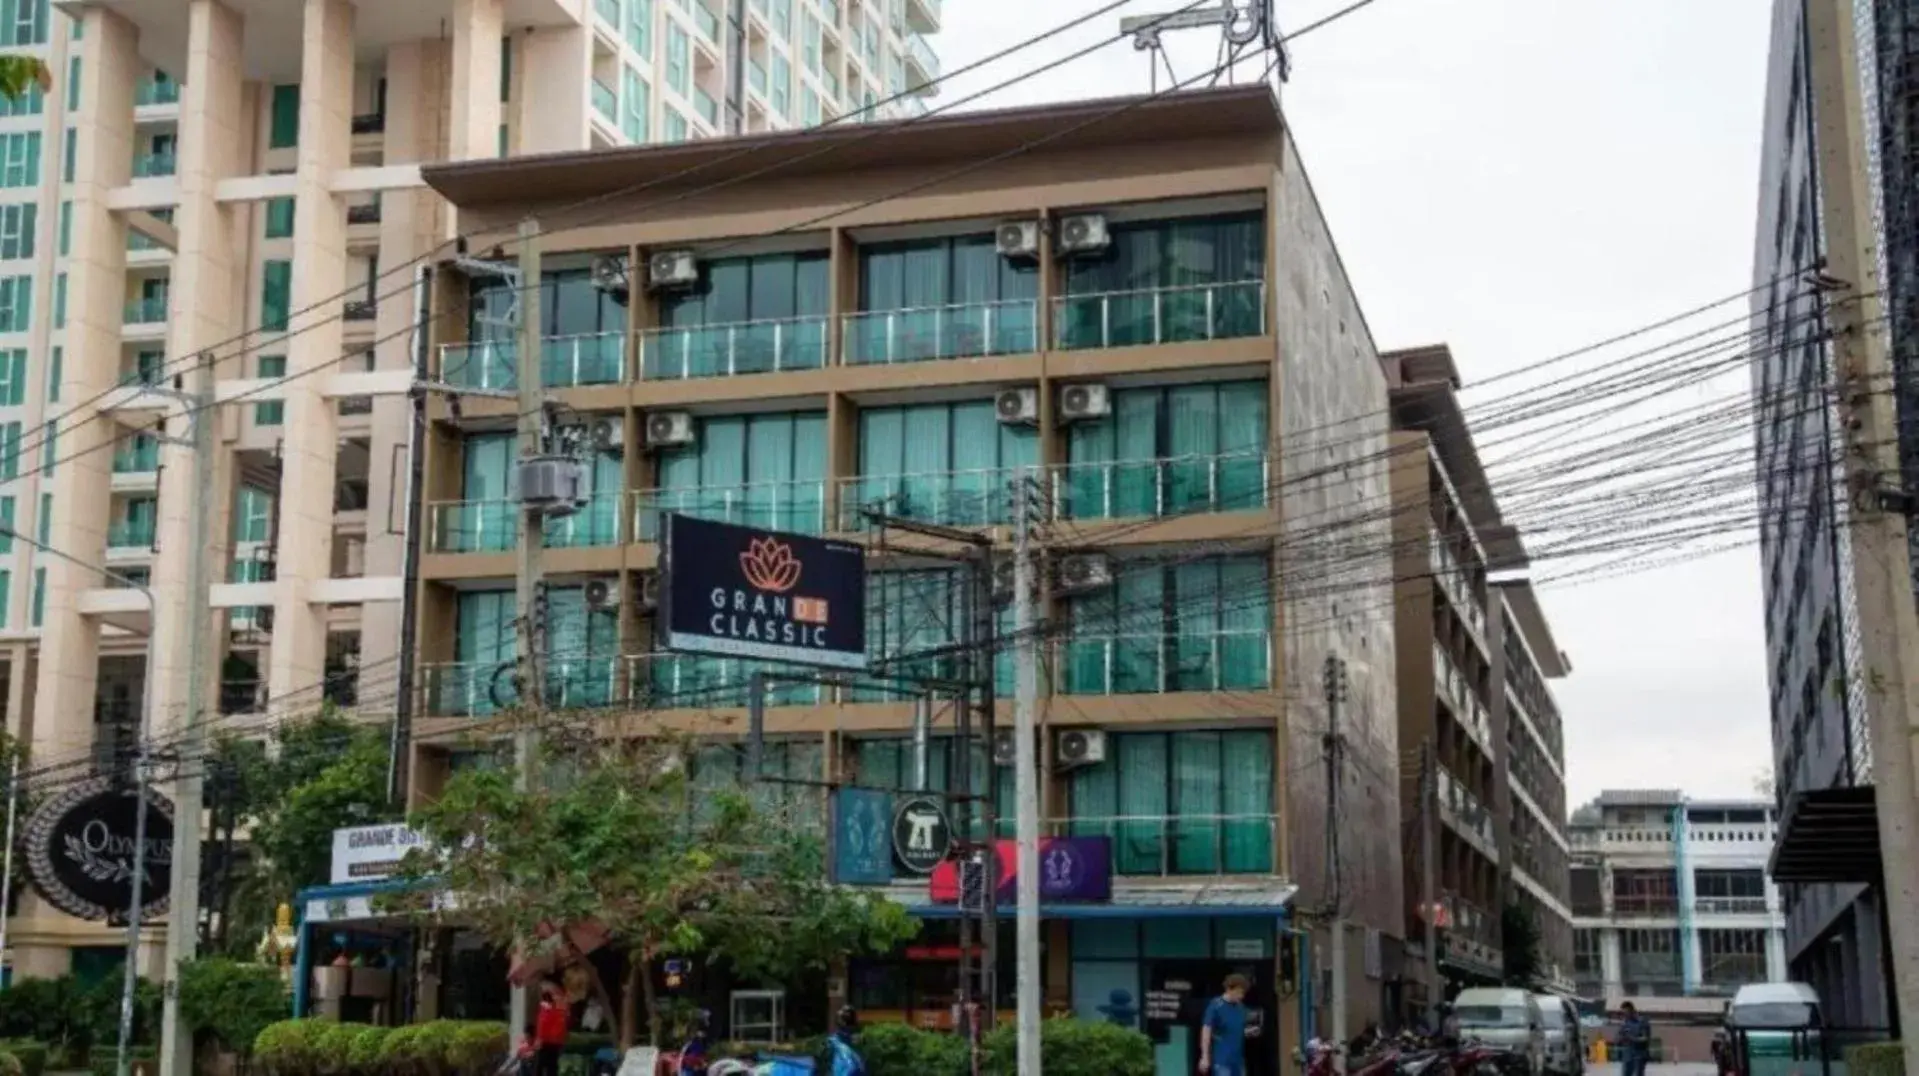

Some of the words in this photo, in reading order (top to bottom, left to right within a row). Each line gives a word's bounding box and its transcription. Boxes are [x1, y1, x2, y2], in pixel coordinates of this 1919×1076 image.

[710, 587, 828, 624] GRANDE
[710, 614, 826, 646] CLASSIC
[349, 828, 394, 849] GRANDE
